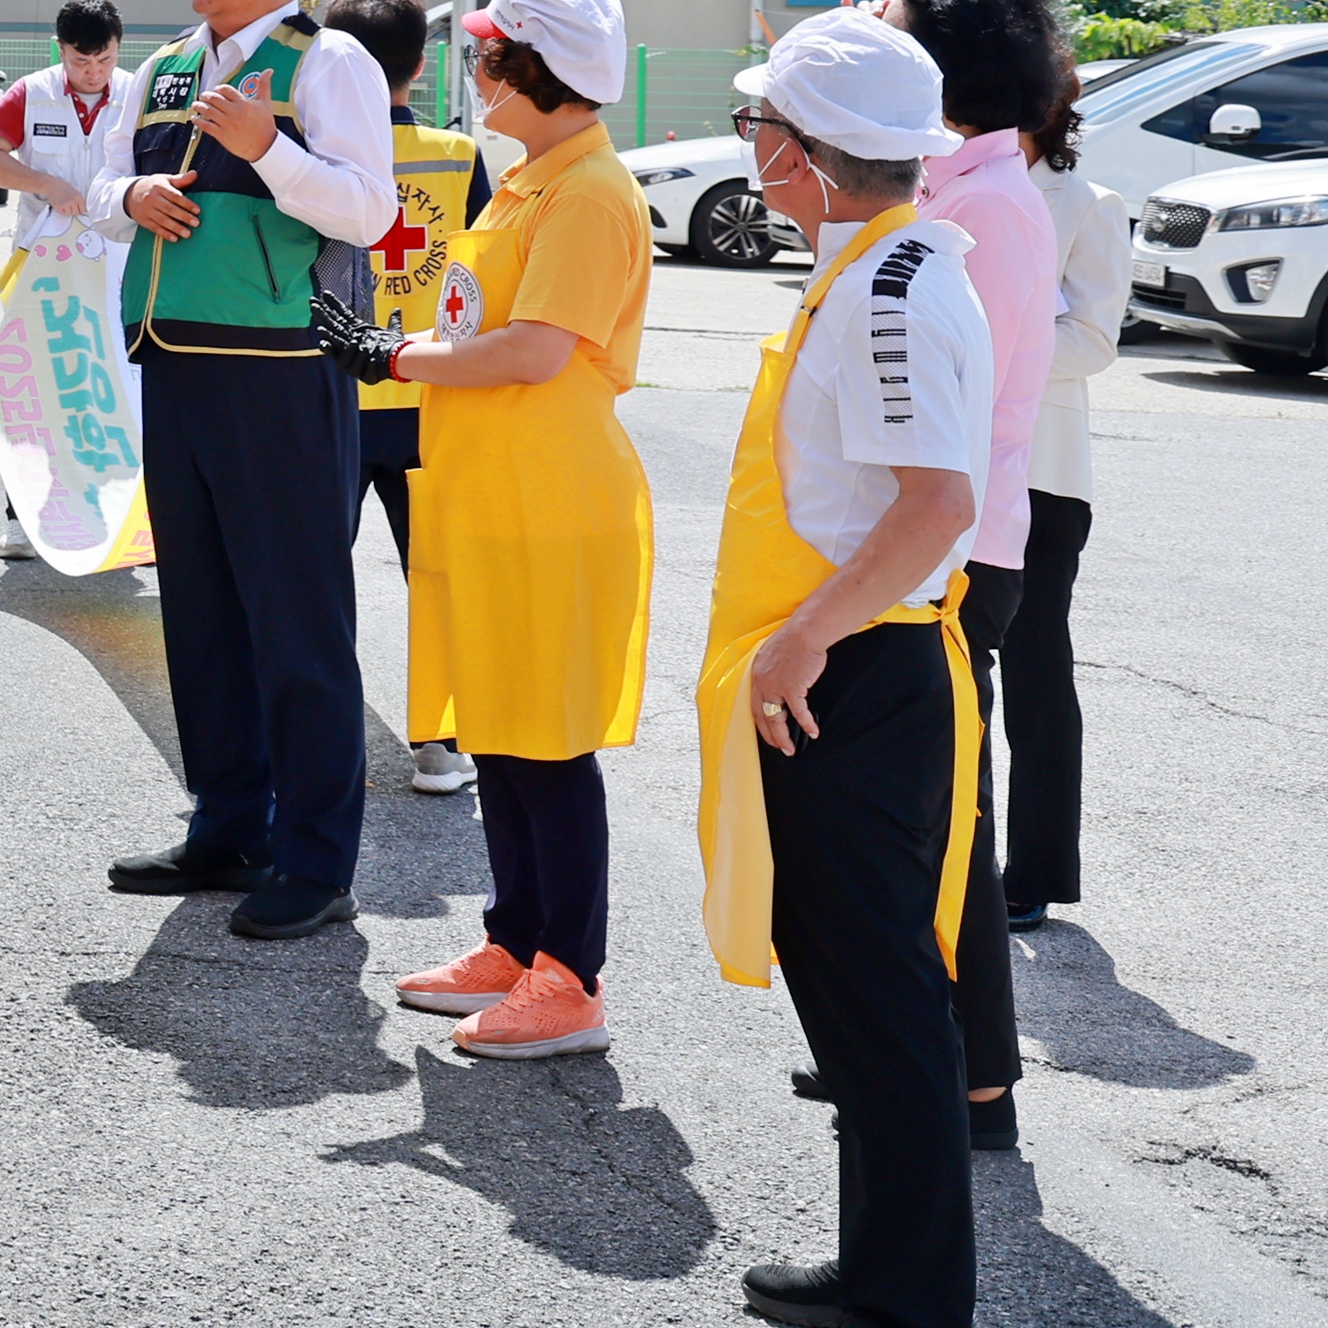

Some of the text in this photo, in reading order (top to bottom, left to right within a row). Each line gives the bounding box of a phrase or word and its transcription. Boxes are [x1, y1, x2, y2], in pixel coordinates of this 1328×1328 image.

[396, 182, 445, 224] 십자사
[384, 276, 412, 296] RED
[414, 240, 447, 286] CROSS
